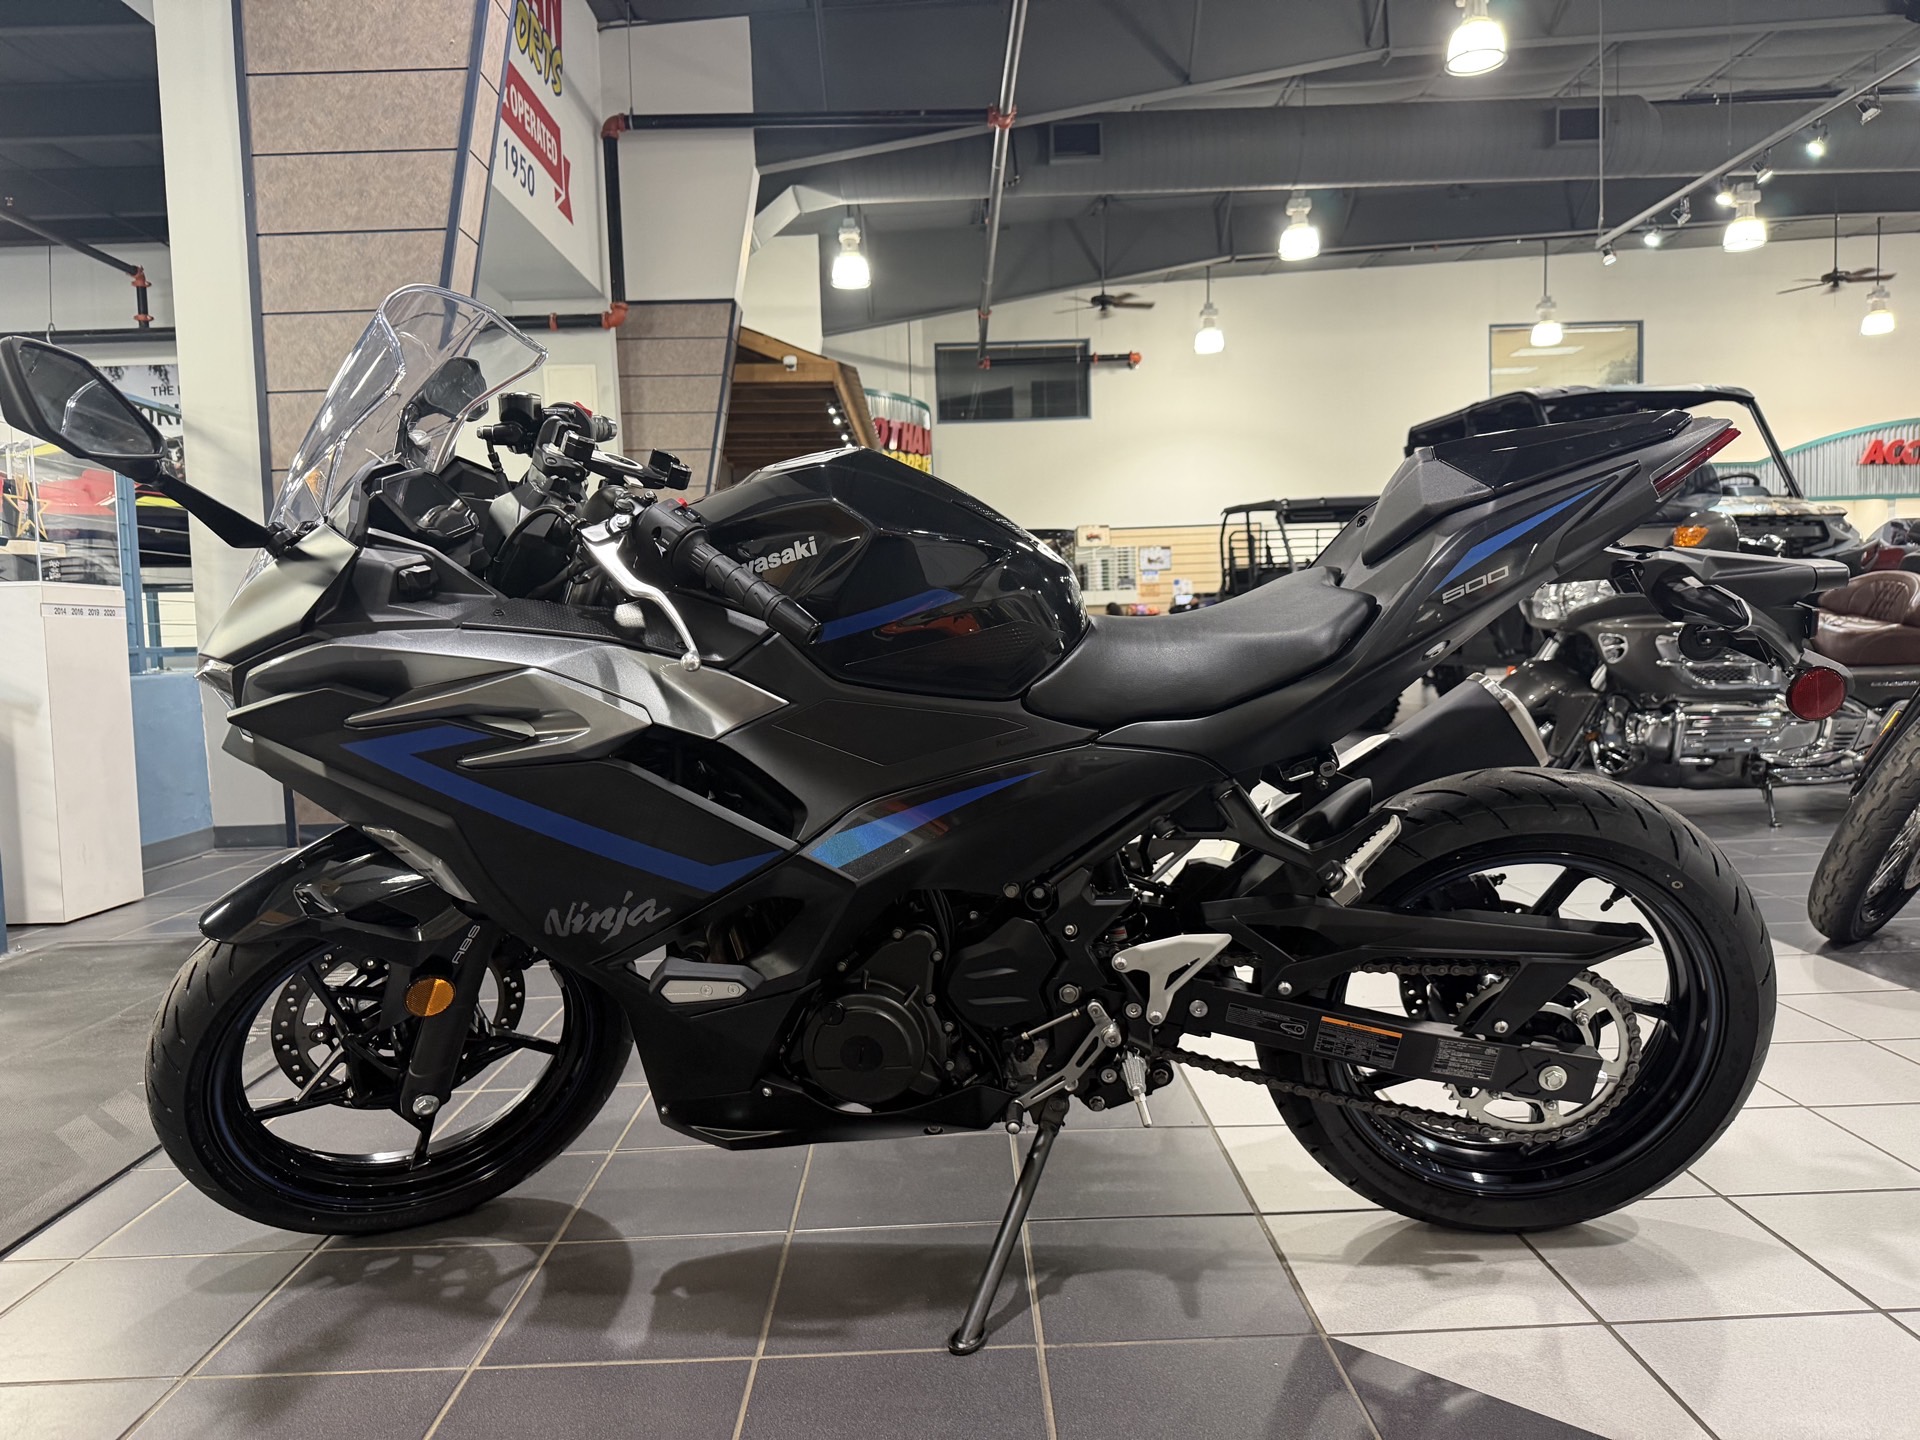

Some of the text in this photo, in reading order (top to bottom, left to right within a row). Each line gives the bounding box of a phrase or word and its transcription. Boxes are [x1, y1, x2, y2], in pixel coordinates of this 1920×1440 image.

[510, 84, 558, 166] OPERATED
[504, 138, 535, 197] 1950
[151, 385, 174, 396] THE
[1442, 565, 1509, 605] 500
[544, 890, 671, 944] Ninja
[452, 924, 480, 964] ABS
